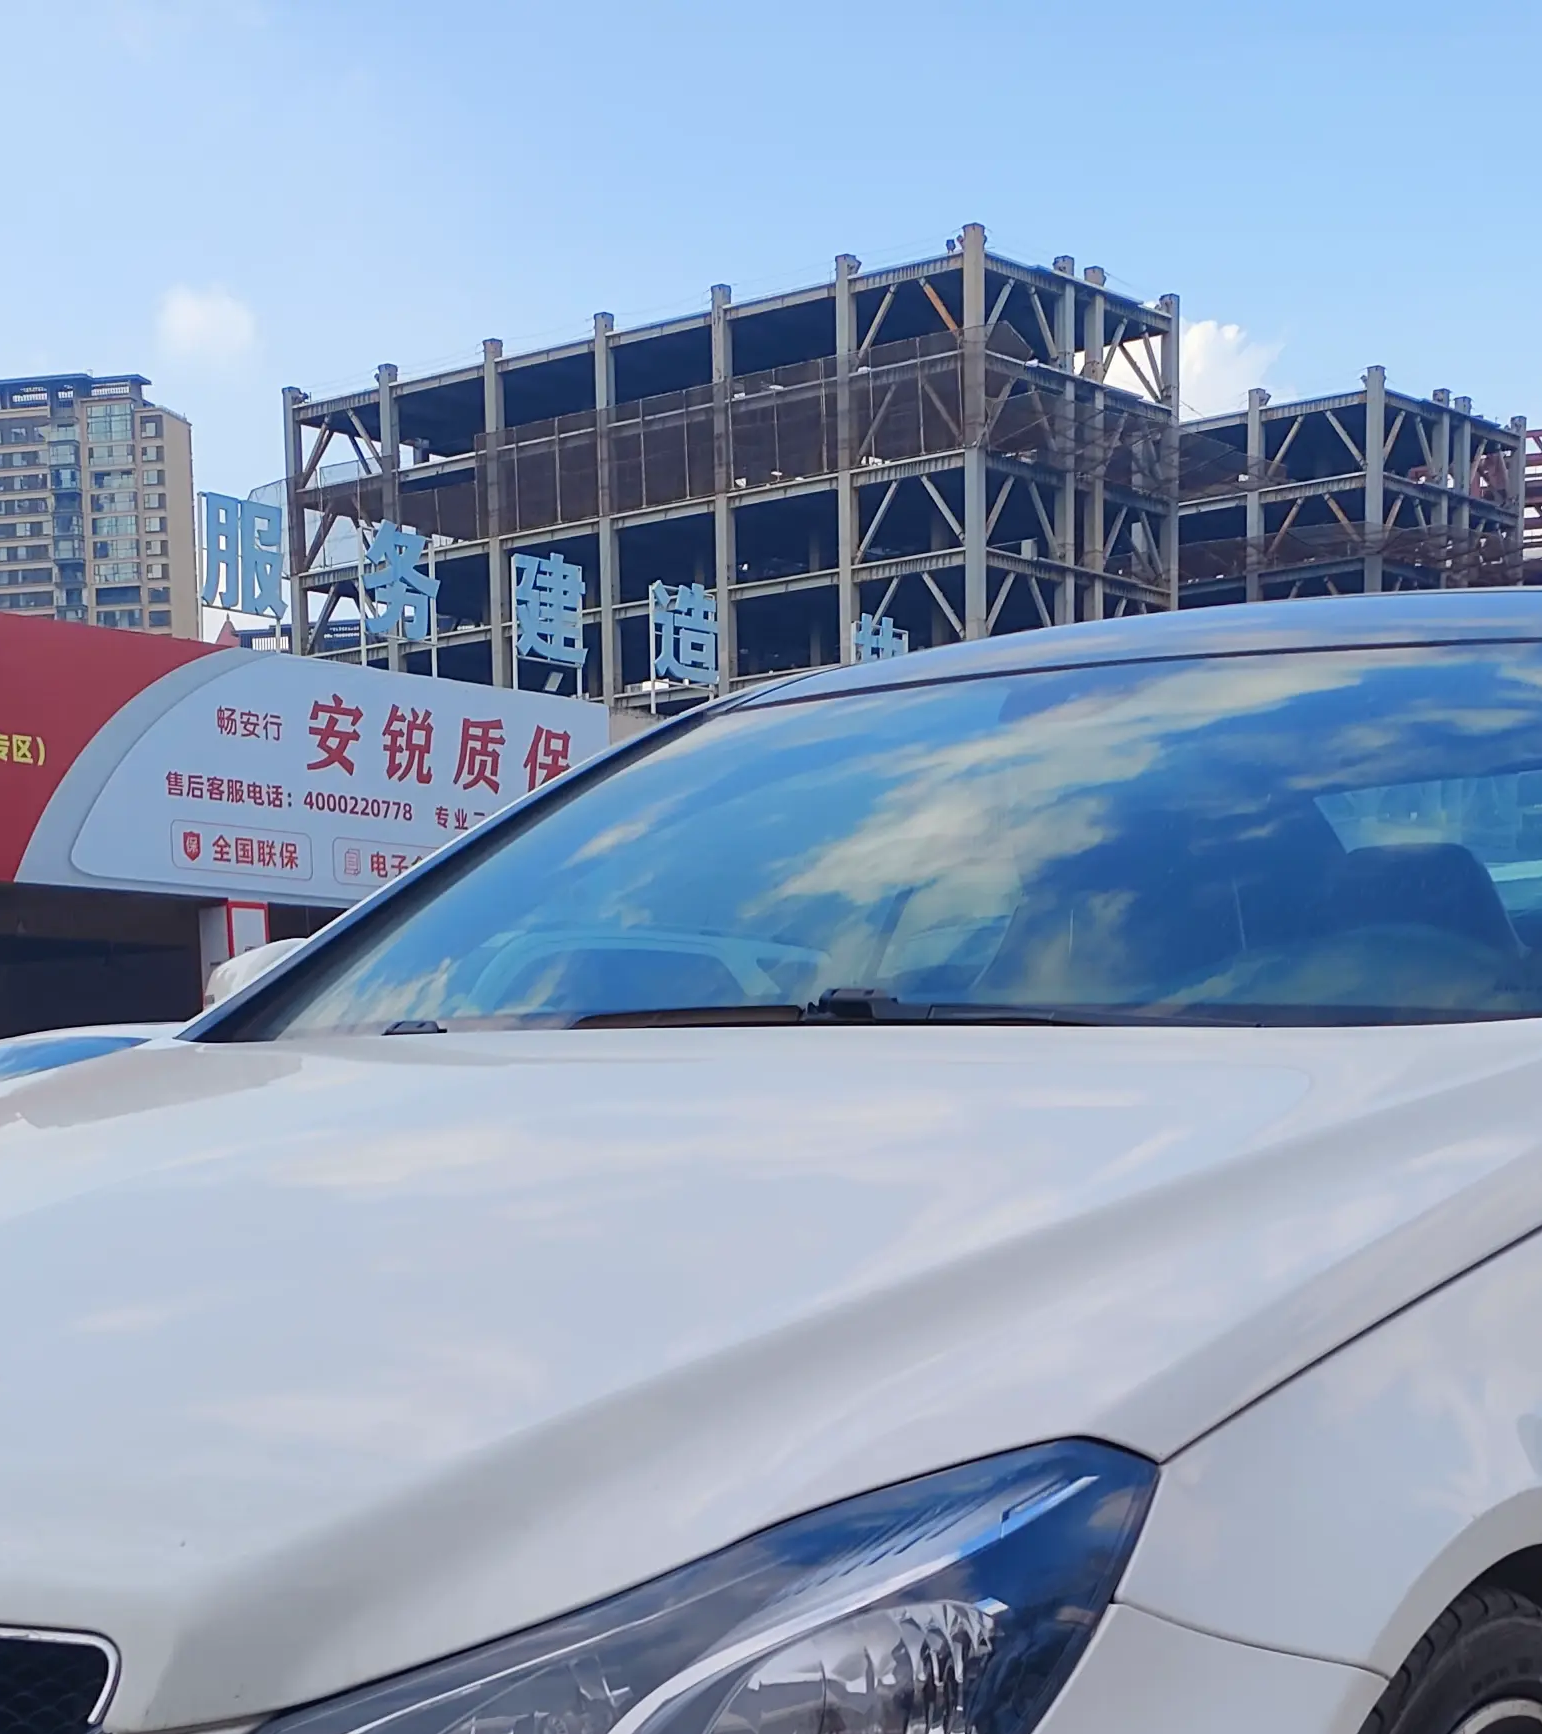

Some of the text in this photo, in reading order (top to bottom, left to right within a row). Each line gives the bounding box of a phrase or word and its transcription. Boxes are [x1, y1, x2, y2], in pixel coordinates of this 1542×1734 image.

[216, 706, 283, 742] 畅安行
[306, 693, 571, 794] 安锐质保
[435, 805, 485, 830] 专业
[212, 834, 299, 869] 全国联保
[370, 851, 423, 877] 电子
